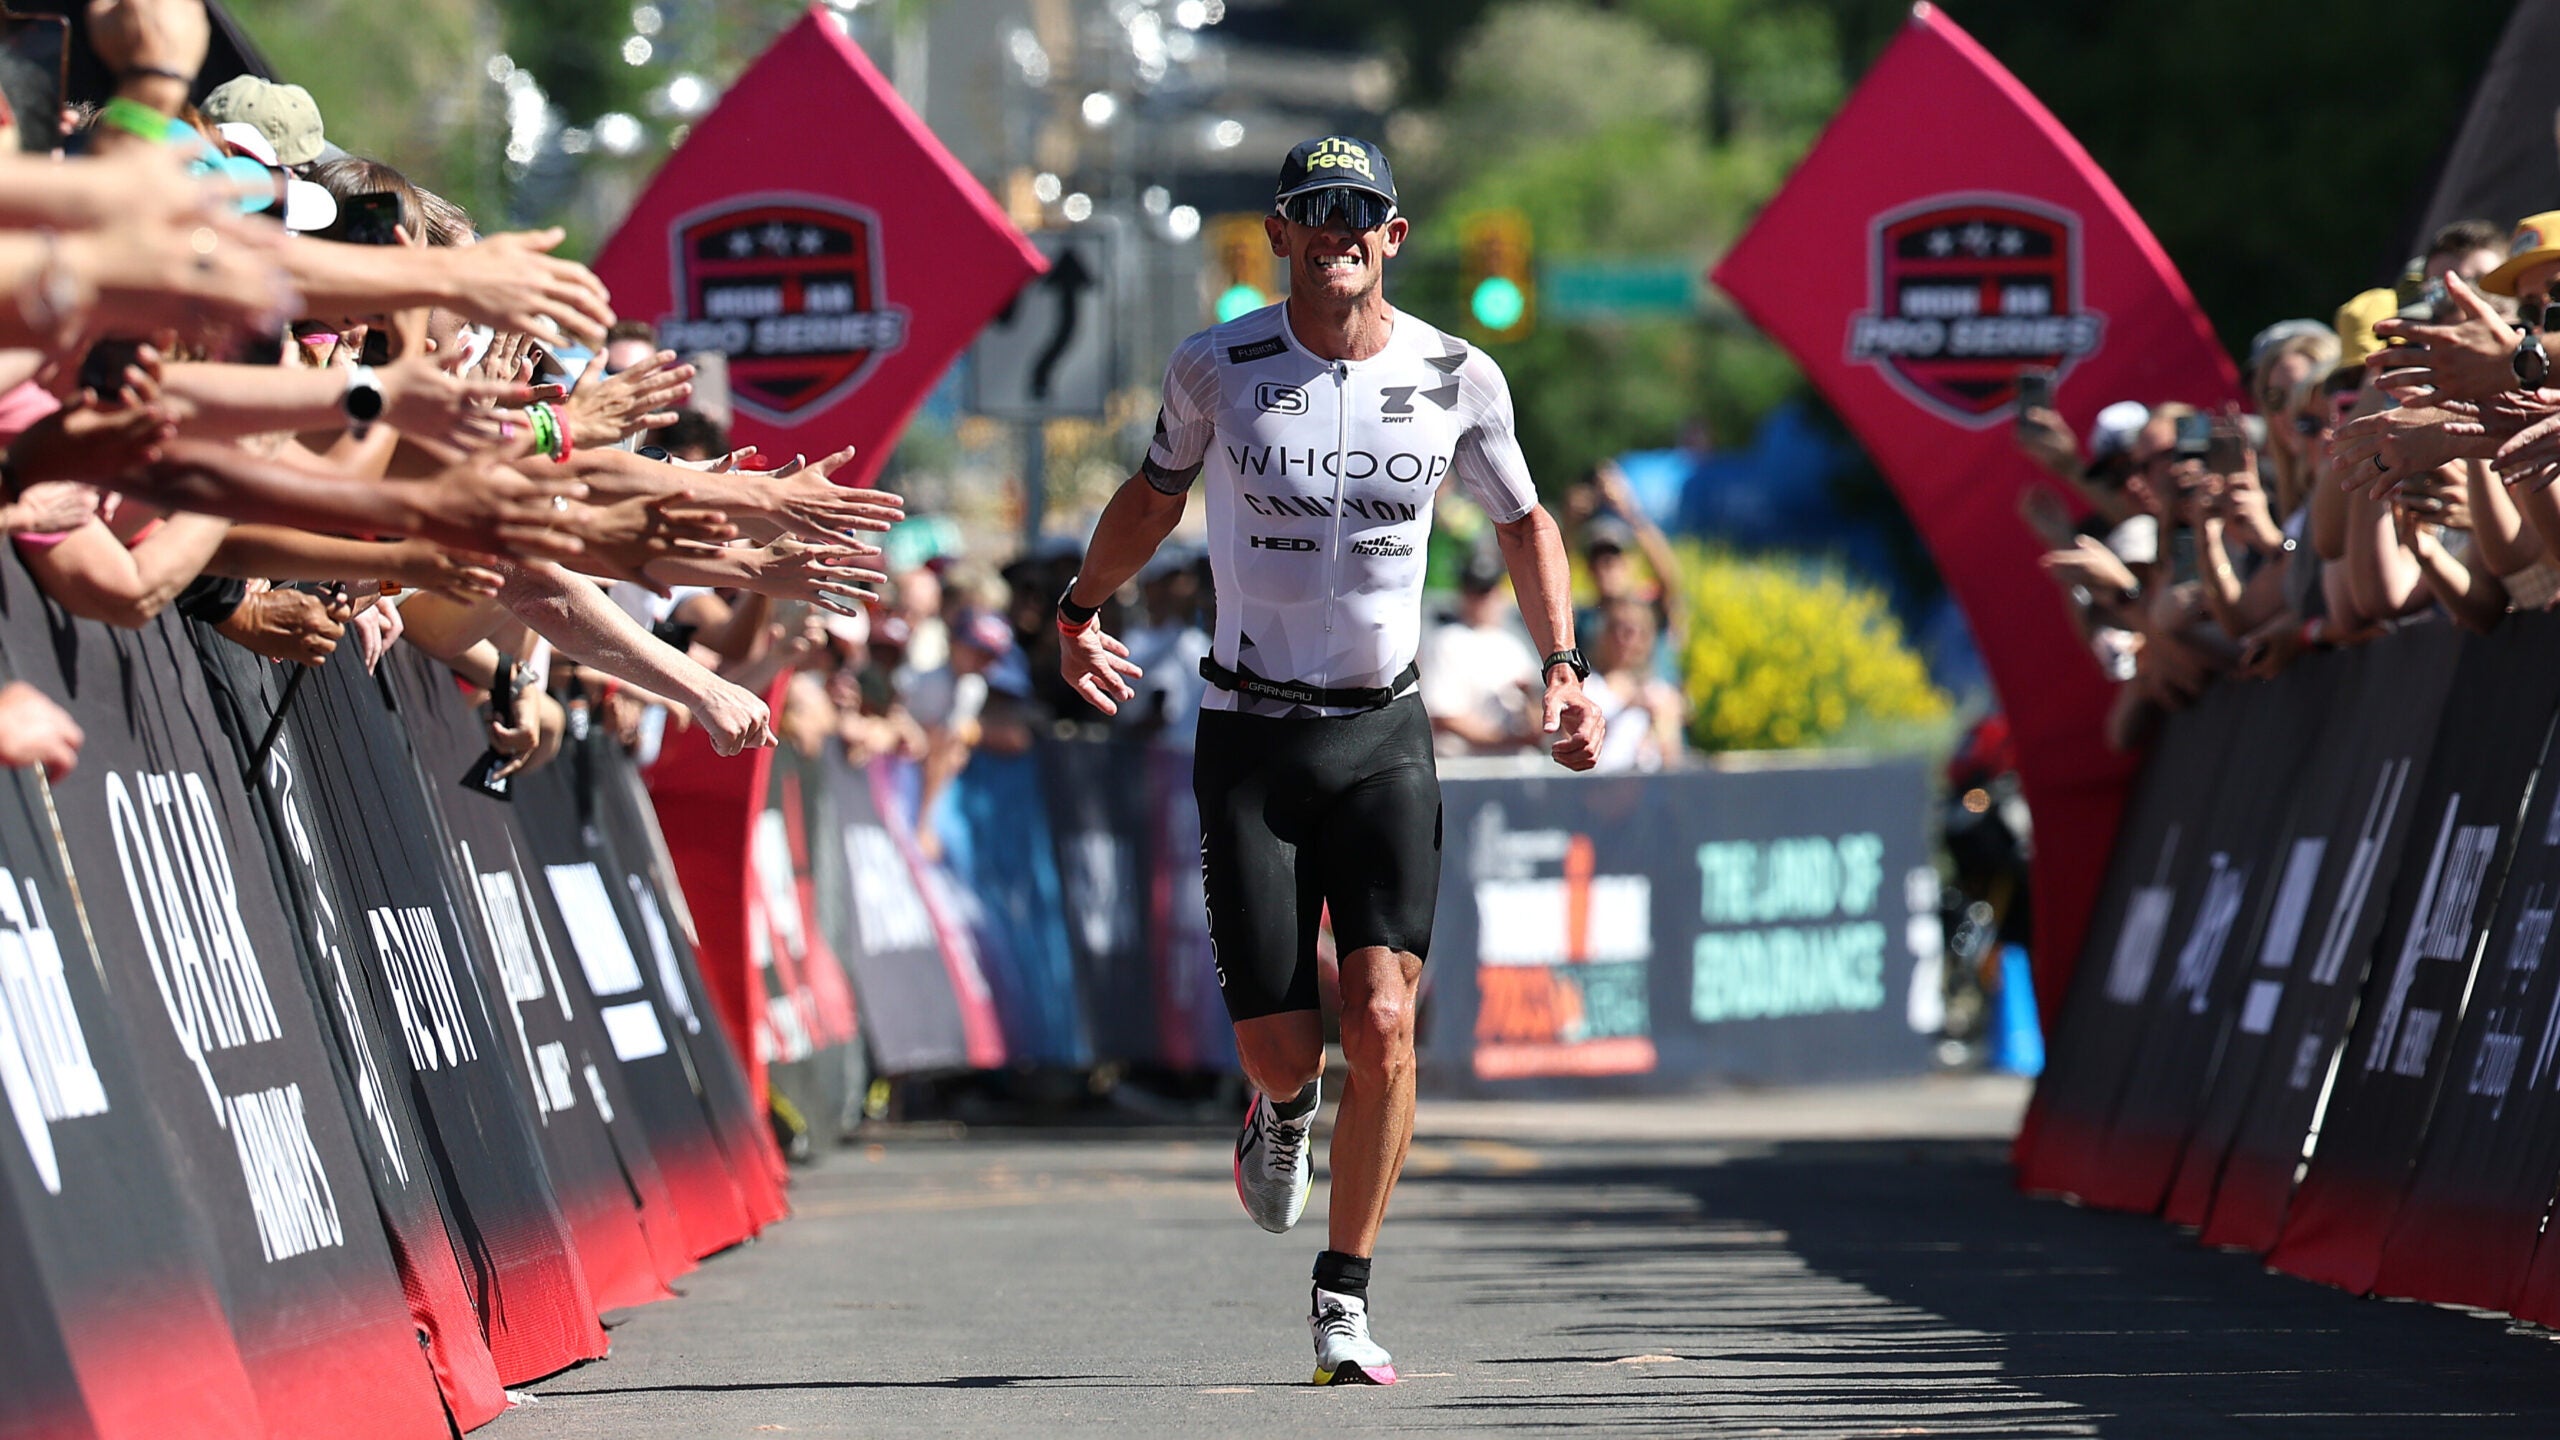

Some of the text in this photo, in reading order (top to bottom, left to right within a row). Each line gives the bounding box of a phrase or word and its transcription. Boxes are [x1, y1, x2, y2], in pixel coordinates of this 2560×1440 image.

[1317, 137, 1366, 158] The
[1307, 151, 1376, 181] Feed.
[660, 311, 903, 355] PRO SERIES
[1853, 314, 2101, 357] PRO SERIES
[1237, 341, 1278, 358] FUSION
[1381, 416, 1414, 424] ZWIFT
[1227, 445, 1448, 486] WHOOP
[1243, 493, 1417, 522] CANYON
[1250, 535, 1321, 552] HED.
[1248, 681, 1313, 701] GARNEAU
[106, 770, 283, 1129] QATAR
[367, 906, 478, 1072] ROUVY
[224, 1082, 344, 1263] AIRWAYS
